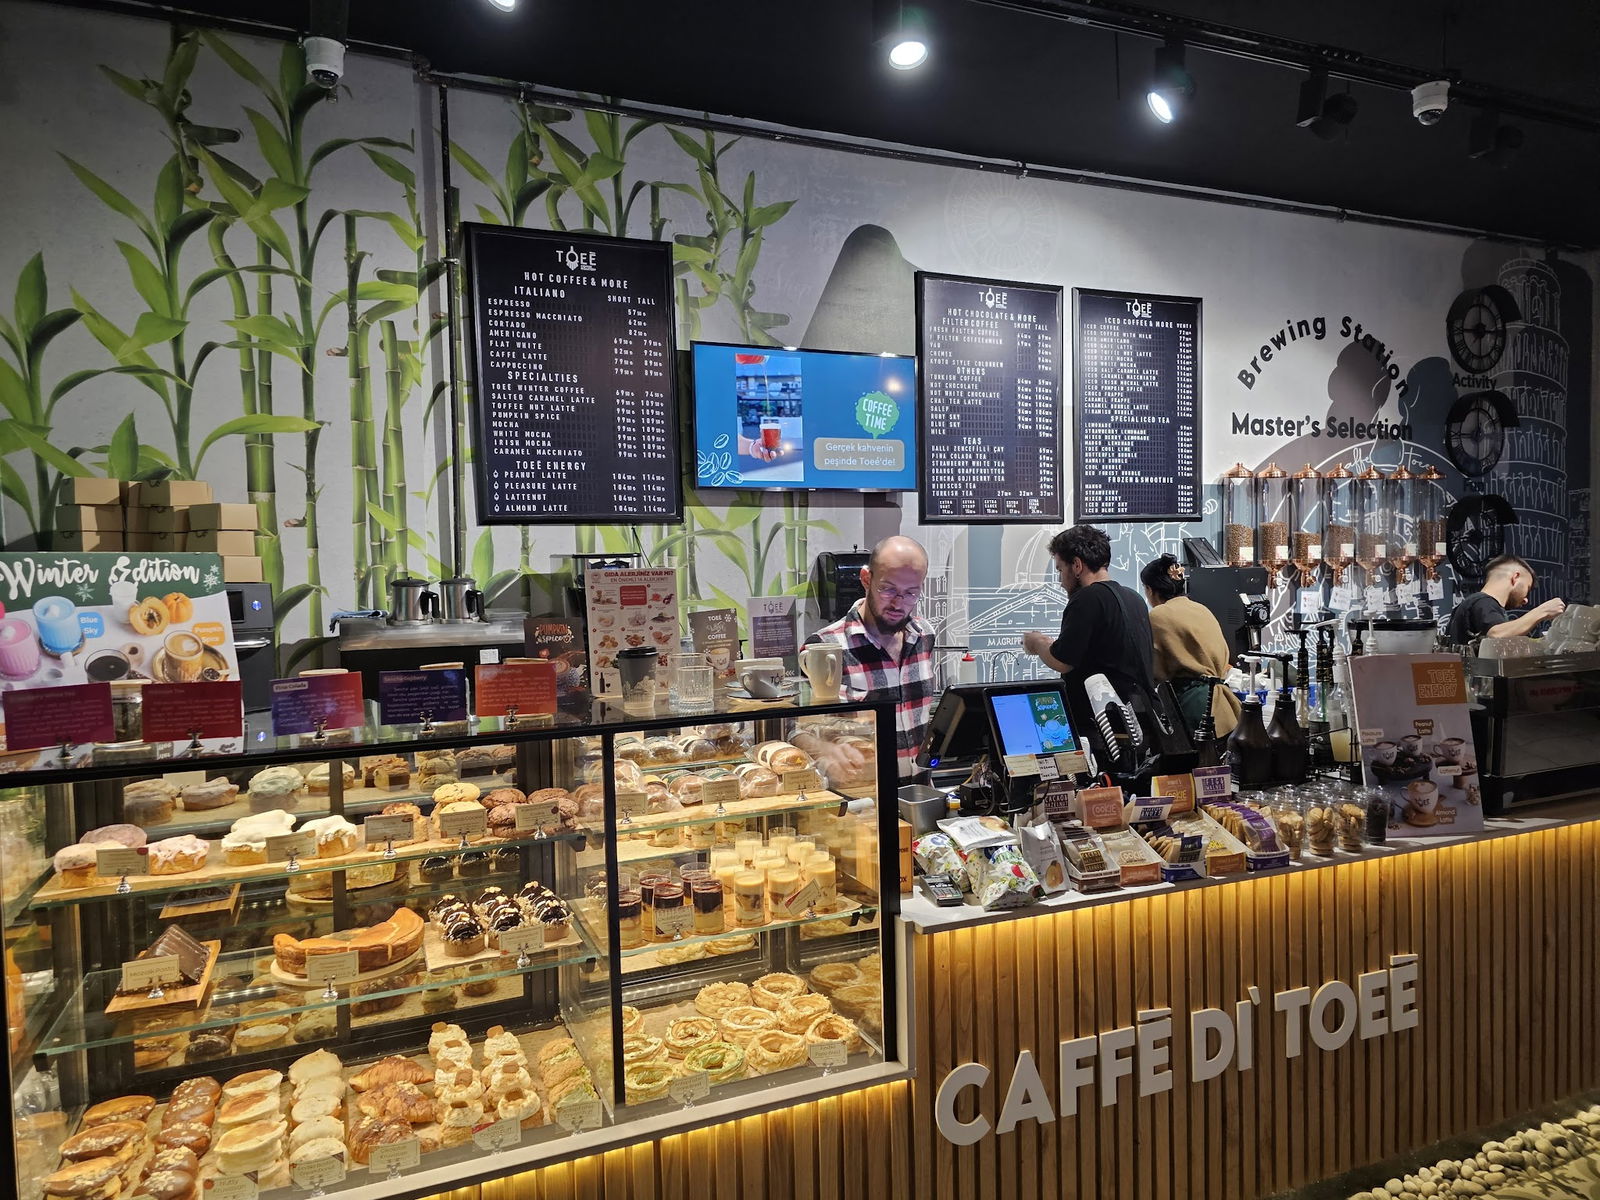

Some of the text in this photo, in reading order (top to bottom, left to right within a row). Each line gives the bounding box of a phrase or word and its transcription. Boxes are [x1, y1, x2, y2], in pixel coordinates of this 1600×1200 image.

[524, 272, 544, 282] HOT
[549, 273, 588, 287] COFFEE
[601, 279, 628, 289] MORE
[515, 286, 565, 298] ITALIANO
[488, 298, 530, 308] ESPRESSO
[608, 295, 655, 305] SHORT TALL
[489, 309, 583, 322] ESPRESSO MACCHIATO
[948, 308, 961, 316] HOT
[965, 310, 1008, 320] CHOCOLATE
[1018, 314, 1037, 323] MORE
[489, 320, 525, 329] CORTADO
[943, 317, 998, 329] FILTER COFFEE
[1123, 318, 1147, 327] COFFEE
[489, 329, 537, 339] AMERICANO
[490, 340, 542, 350] FLAT WHITE
[523, 353, 547, 361] LATTE
[1237, 317, 1326, 390] Brewing
[1340, 316, 1409, 398] Station
[490, 360, 543, 370] CAPPUCCINO
[957, 366, 986, 376] OTHERS
[508, 371, 578, 383] SPECIALTIES
[1453, 373, 1497, 390] Activity
[518, 385, 549, 393] WINTER
[555, 386, 584, 394] COFFEE
[492, 393, 595, 404] SALTED CARAMEL LATTE
[492, 403, 523, 411] TOFFEE
[551, 404, 575, 412] LATTE
[863, 399, 893, 416] COFFEE
[493, 412, 560, 421] PUMPKIN SPICE
[493, 421, 519, 429] MOCHA
[865, 414, 887, 430] TIME
[1232, 412, 1413, 440] Master's Selection
[494, 430, 551, 439] WHITE MOCHA
[494, 439, 519, 447] IRISH
[963, 437, 981, 445] TEAS
[494, 448, 583, 457] CARAMEL MACCHIATO
[826, 443, 894, 453] Gerçek kahvenin
[547, 461, 586, 471] ENERGY
[824, 457, 857, 467] peşinde
[505, 471, 567, 480] PEANUT LATTE
[505, 482, 546, 490] PLEASURE
[505, 493, 546, 501] LATTENUT
[505, 504, 537, 512] ALMOND
[0, 556, 200, 601] Winter Edition
[80, 616, 98, 624] Blue
[83, 627, 98, 636] Sky
[1418, 684, 1457, 699] ENERGY
